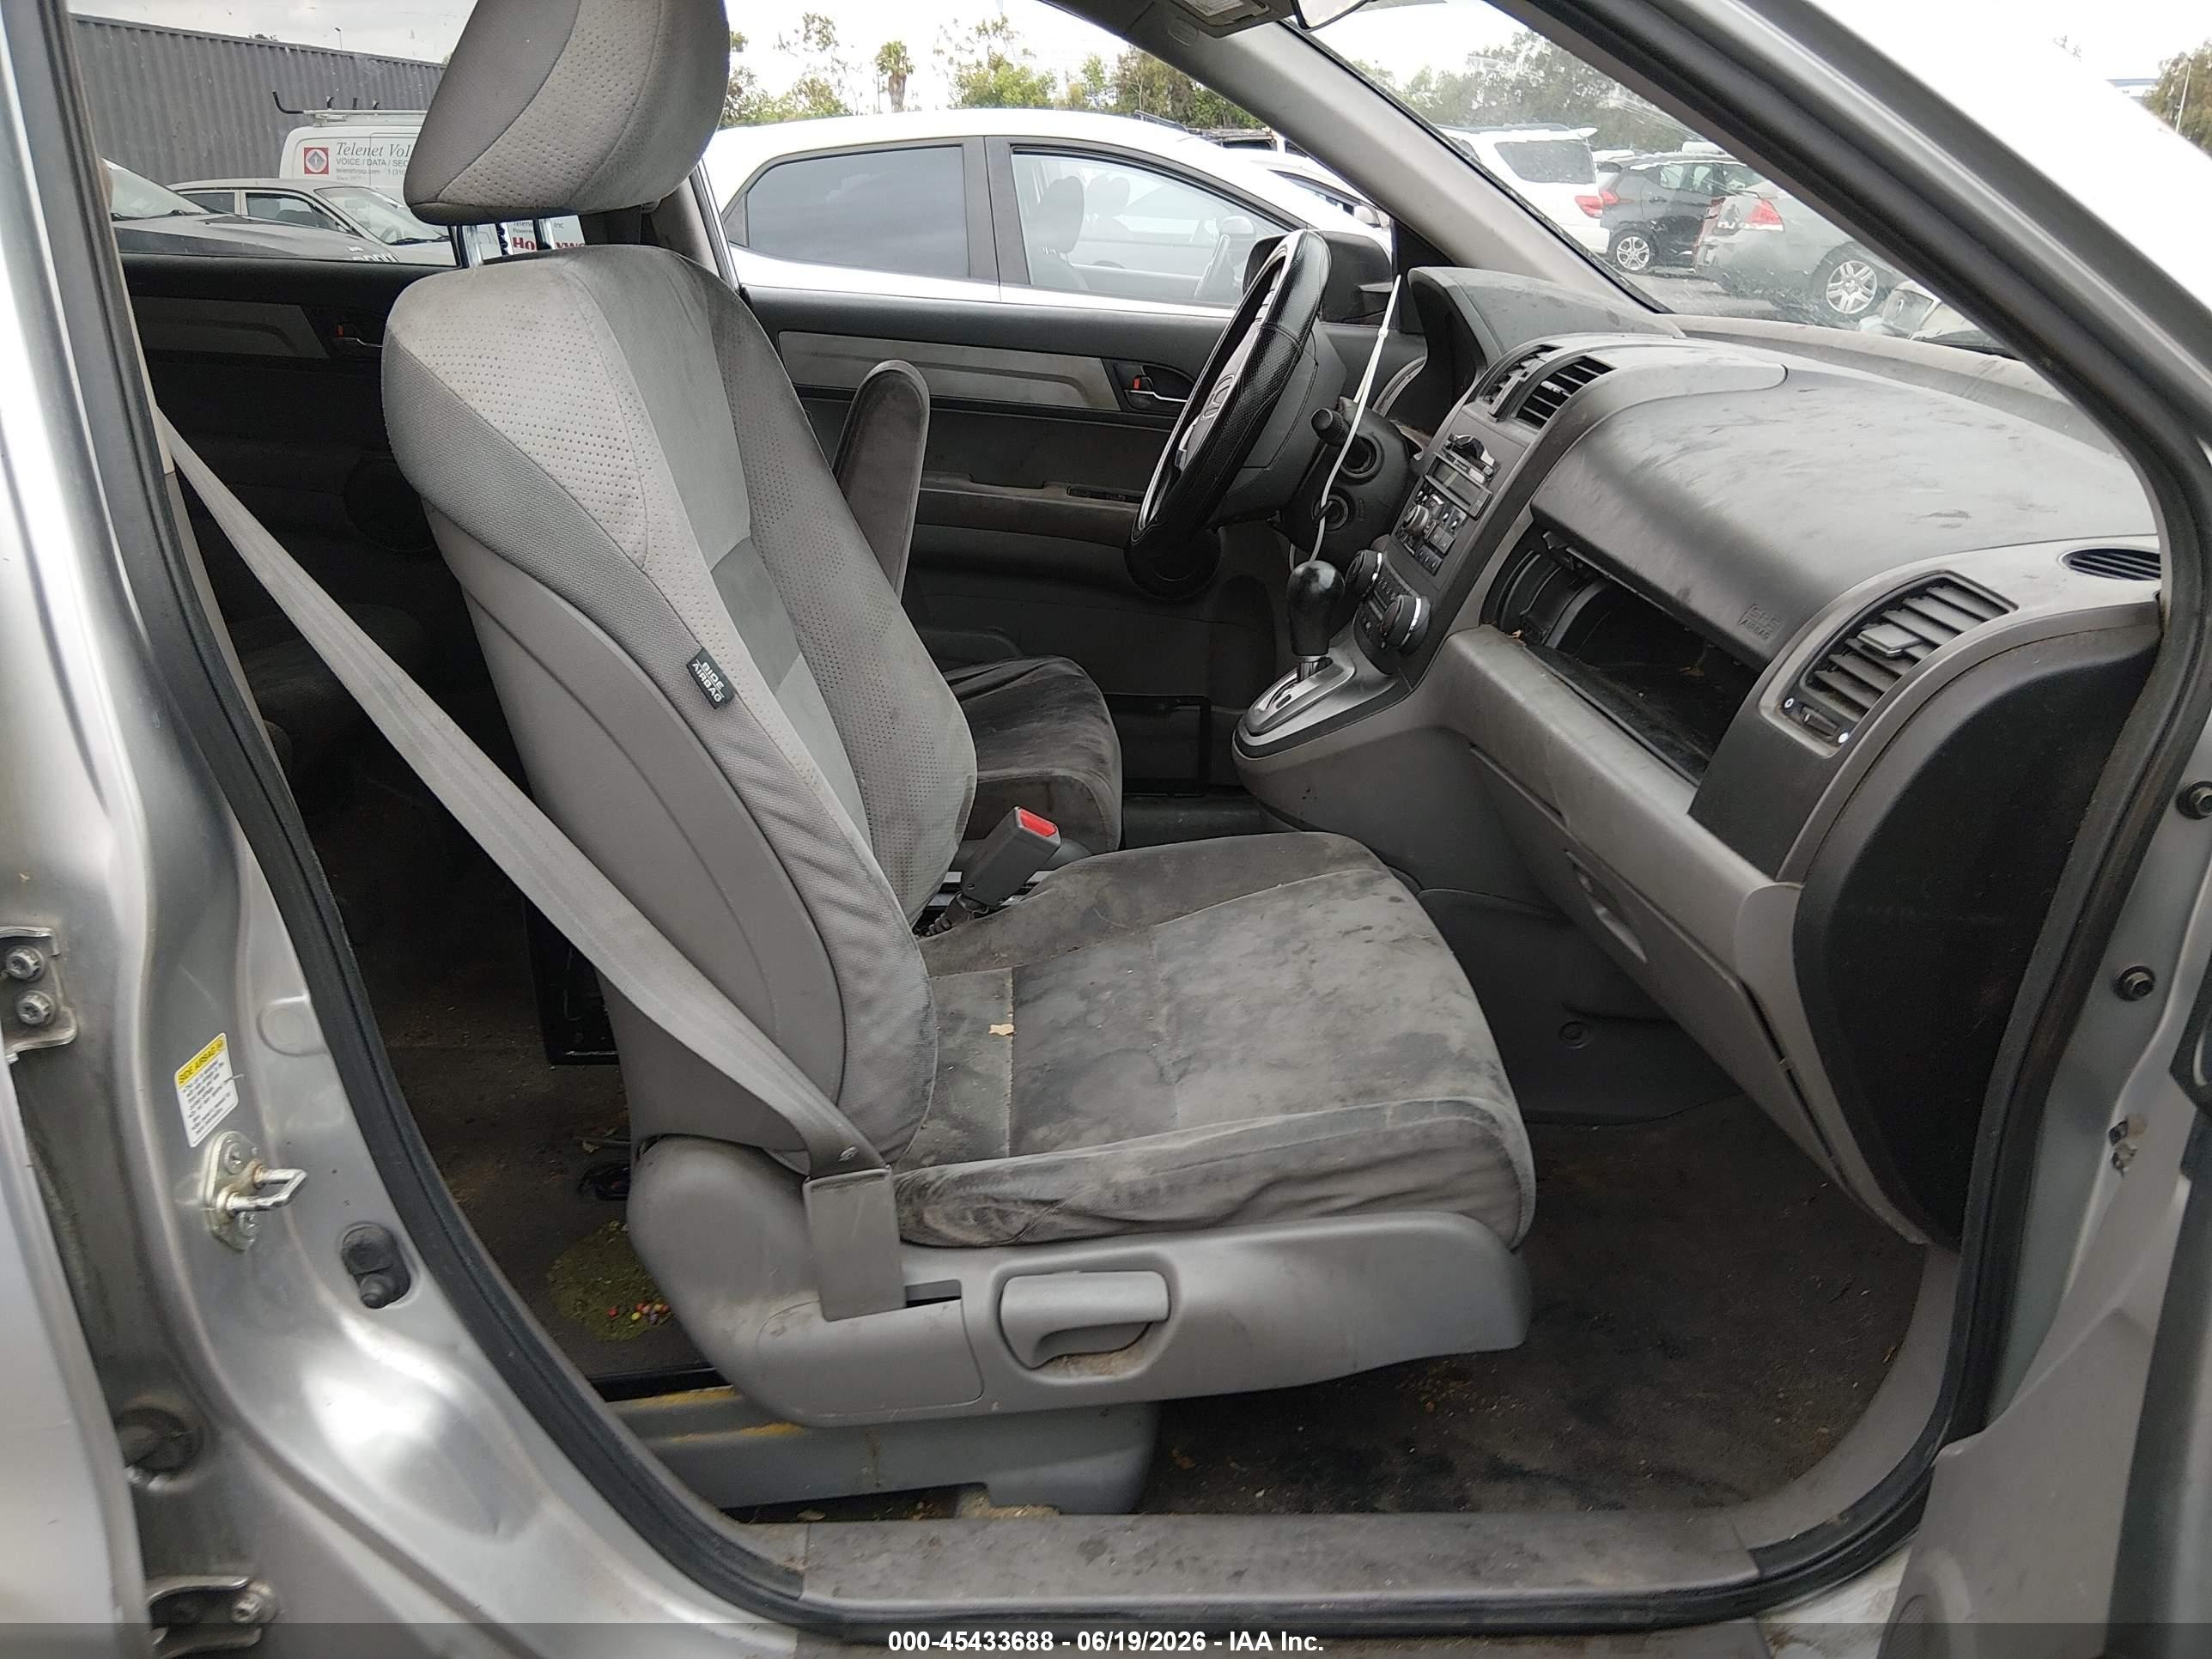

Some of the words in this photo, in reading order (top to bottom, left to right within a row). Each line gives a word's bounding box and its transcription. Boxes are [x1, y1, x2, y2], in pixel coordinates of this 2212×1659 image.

[337, 142, 384, 156] Telenet
[692, 662, 722, 702] AIRBAG
[702, 661, 725, 690] SIDE
